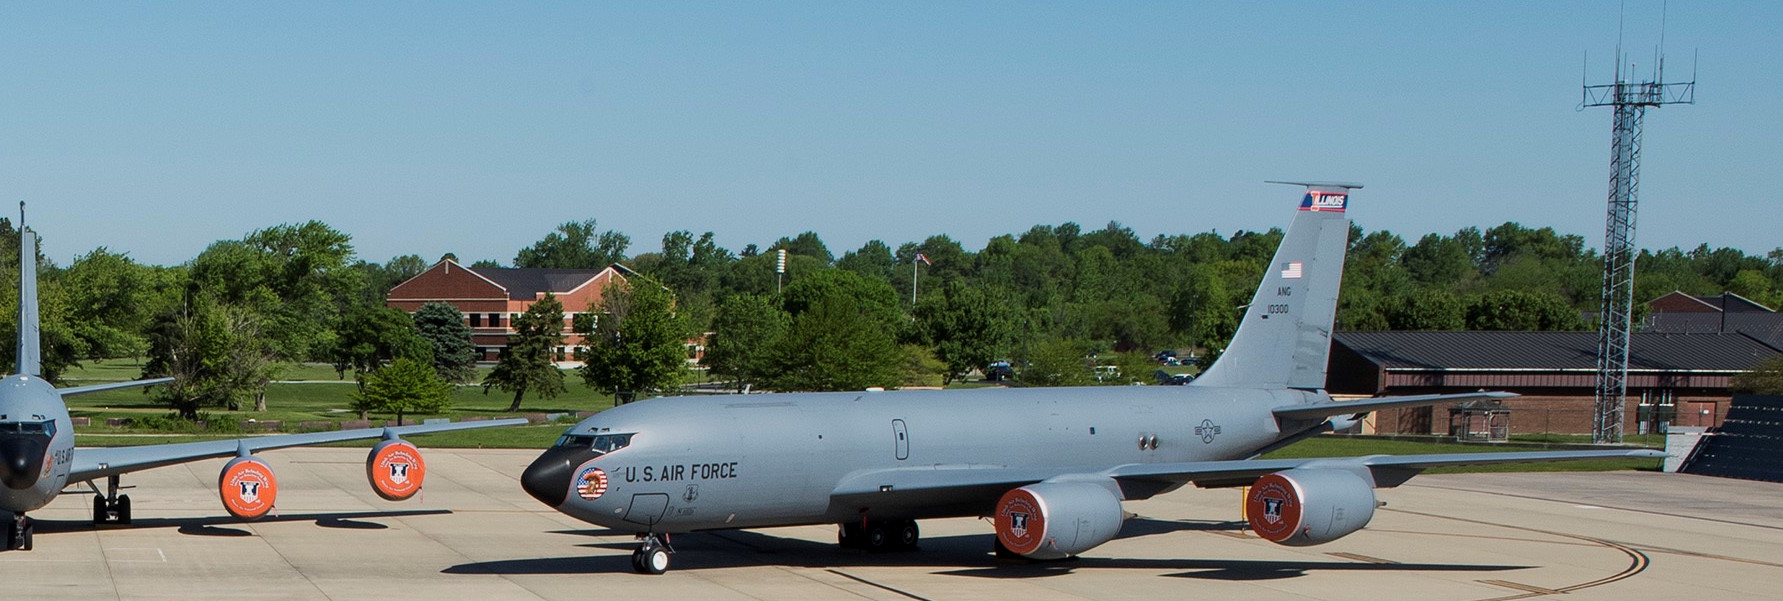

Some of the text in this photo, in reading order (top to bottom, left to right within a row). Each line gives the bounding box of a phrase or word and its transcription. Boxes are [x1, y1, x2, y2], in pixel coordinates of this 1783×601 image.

[1311, 191, 1344, 211] ILLINOIS
[1277, 287, 1291, 297] ANG
[1267, 304, 1289, 314] 10300
[661, 464, 684, 481] AIR
[691, 462, 738, 480] FORCE
